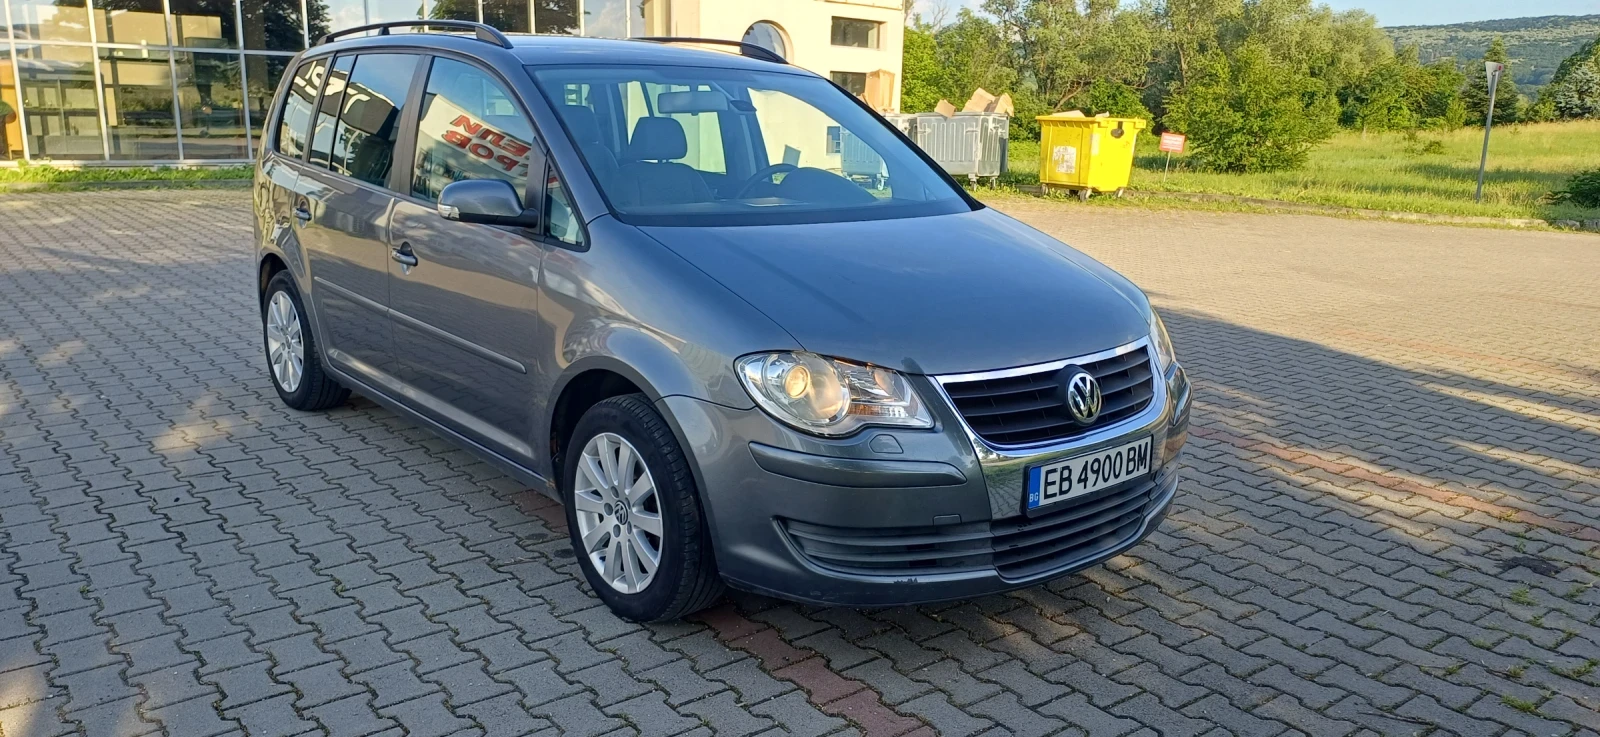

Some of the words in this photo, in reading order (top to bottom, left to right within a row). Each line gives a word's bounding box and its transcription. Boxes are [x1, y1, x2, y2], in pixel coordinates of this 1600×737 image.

[1043, 465, 1073, 500] EB
[1077, 451, 1124, 489] 4900
[1126, 441, 1149, 476] BM
[1029, 492, 1039, 503] BG
